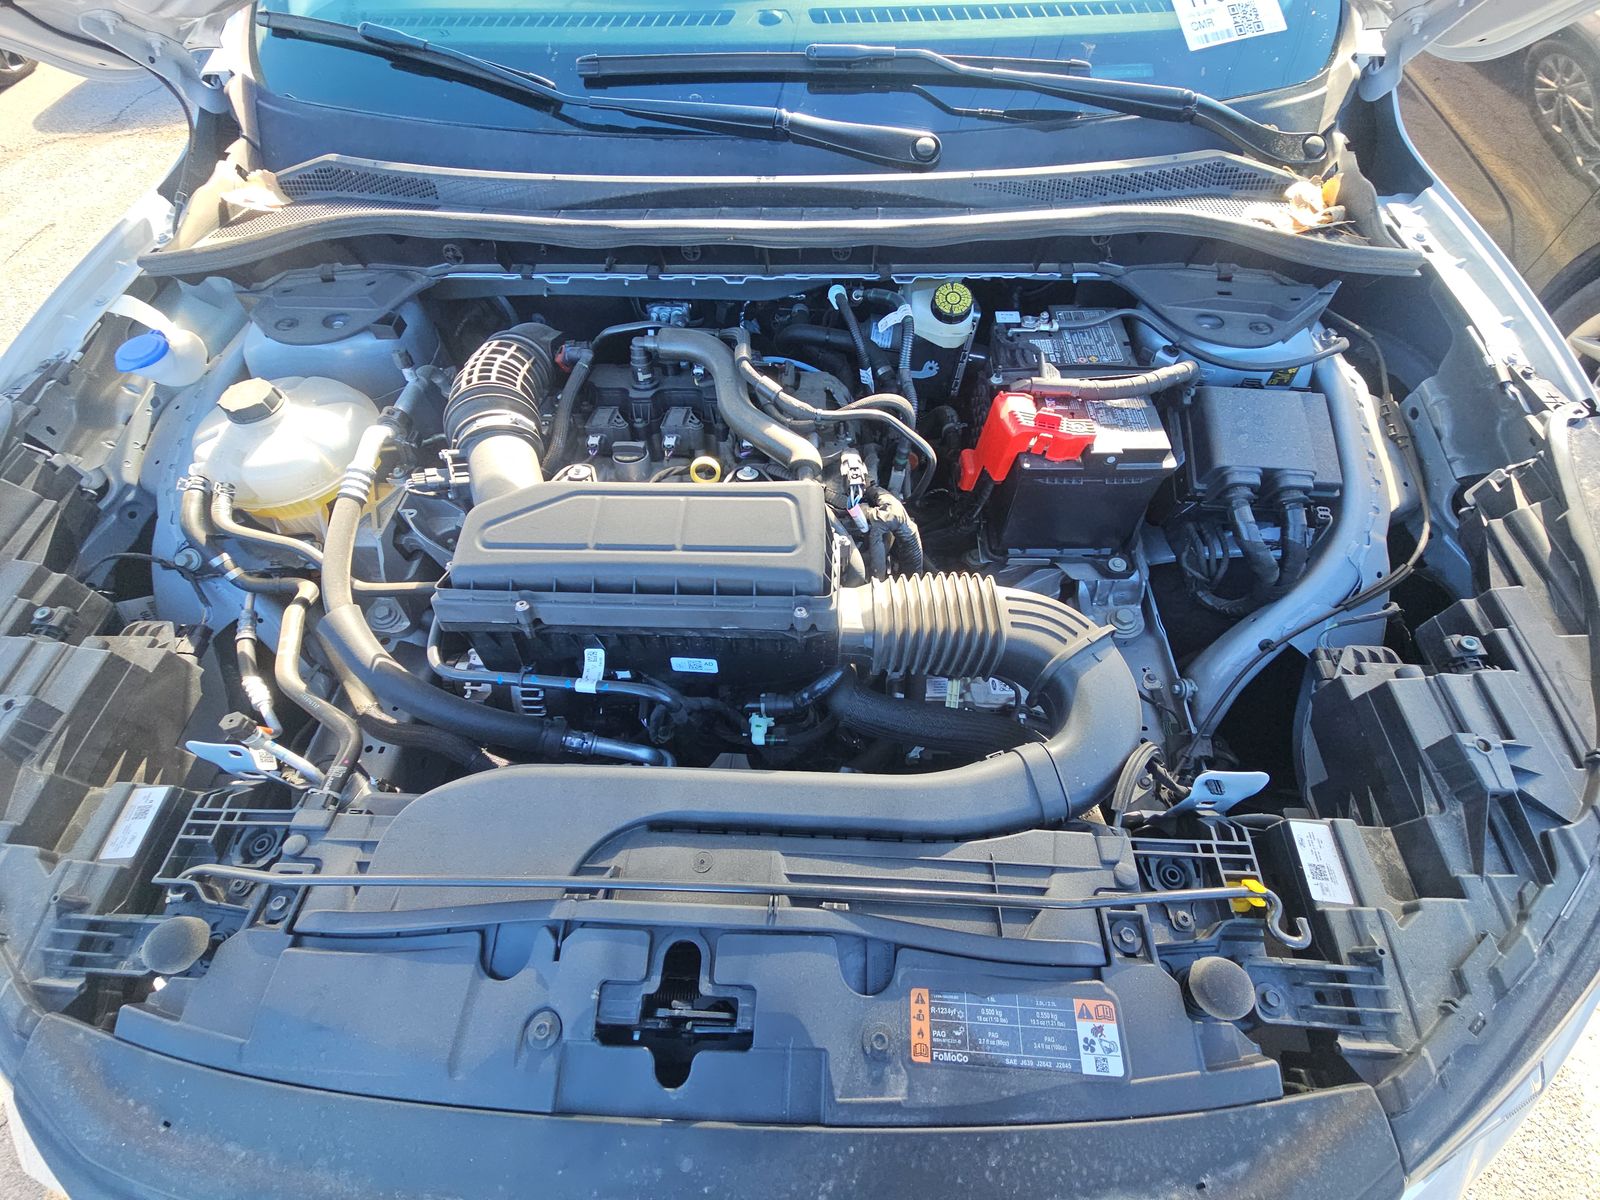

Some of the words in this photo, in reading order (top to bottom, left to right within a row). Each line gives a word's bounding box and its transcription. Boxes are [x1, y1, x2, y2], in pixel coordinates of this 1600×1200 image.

[930, 1006, 957, 1016] R-1234yf
[932, 1051, 969, 1063] FoMoCo
[1005, 1058, 1018, 1066] SAE
